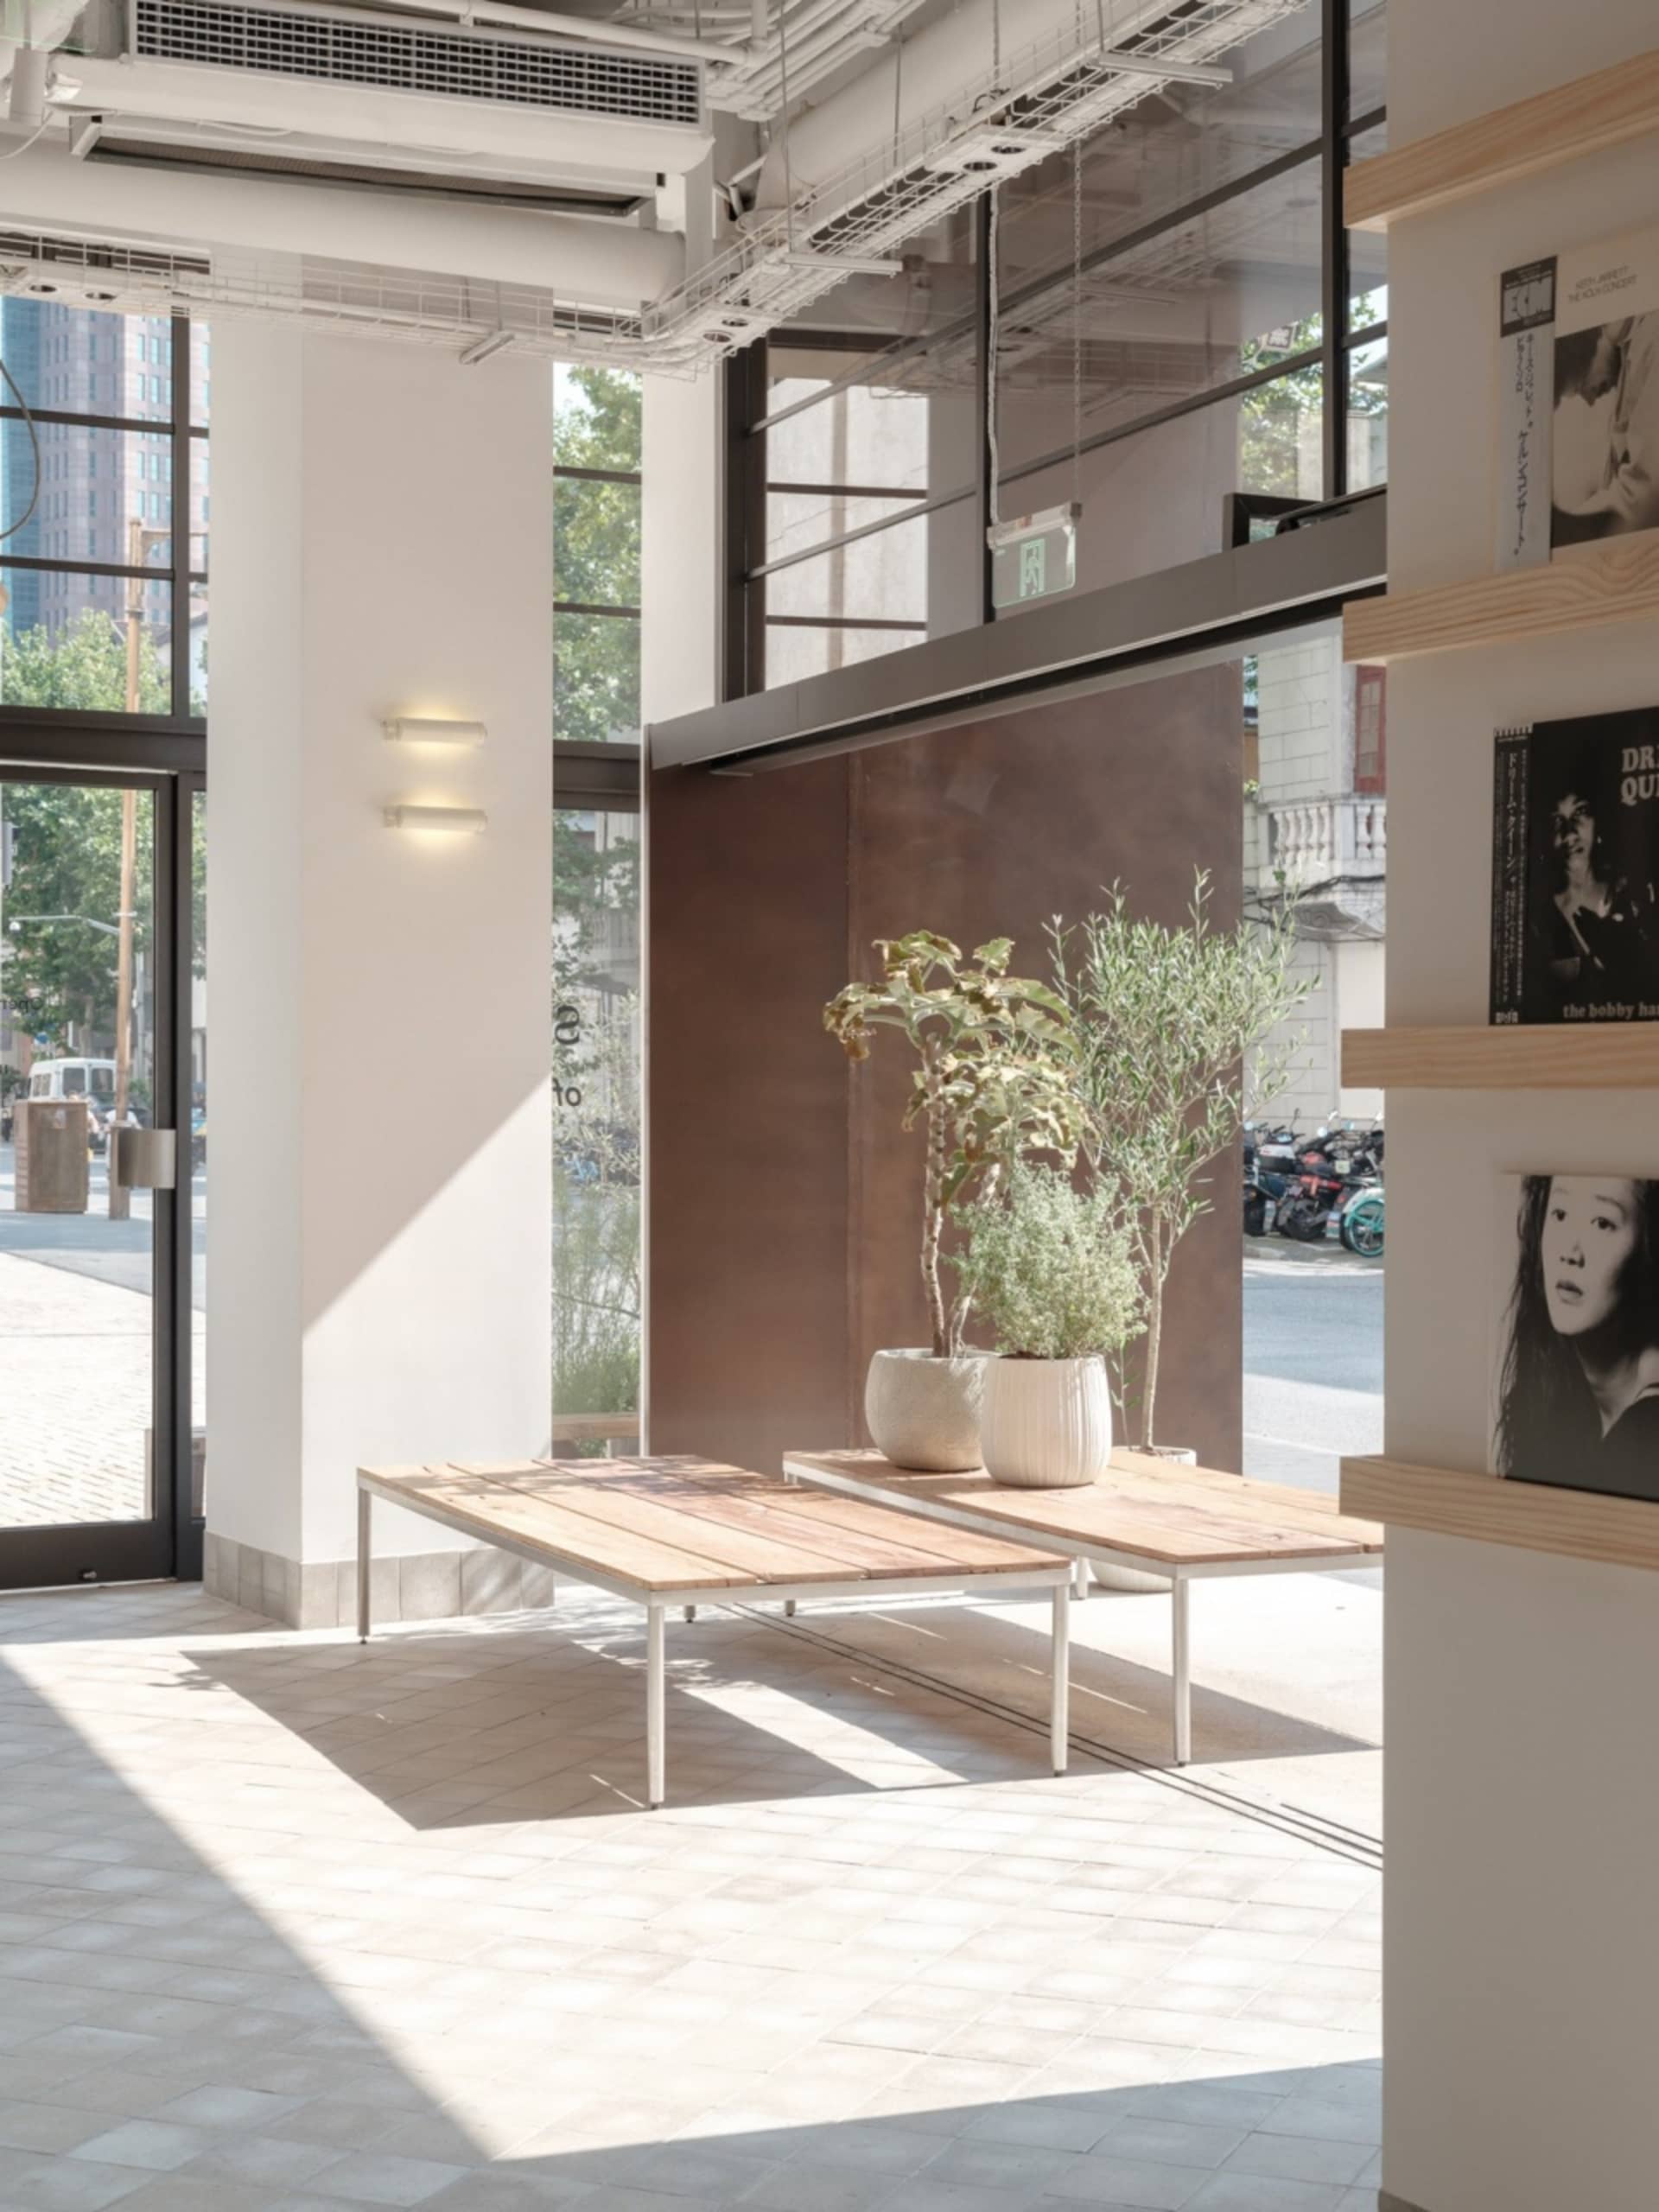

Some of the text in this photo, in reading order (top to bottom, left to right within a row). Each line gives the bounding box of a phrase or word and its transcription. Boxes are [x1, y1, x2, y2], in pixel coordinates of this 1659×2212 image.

[1621, 744, 1659, 773] DR
[1620, 773, 1659, 807] QU
[1562, 1002, 1586, 1019] the
[1587, 1001, 1635, 1020] bobby
